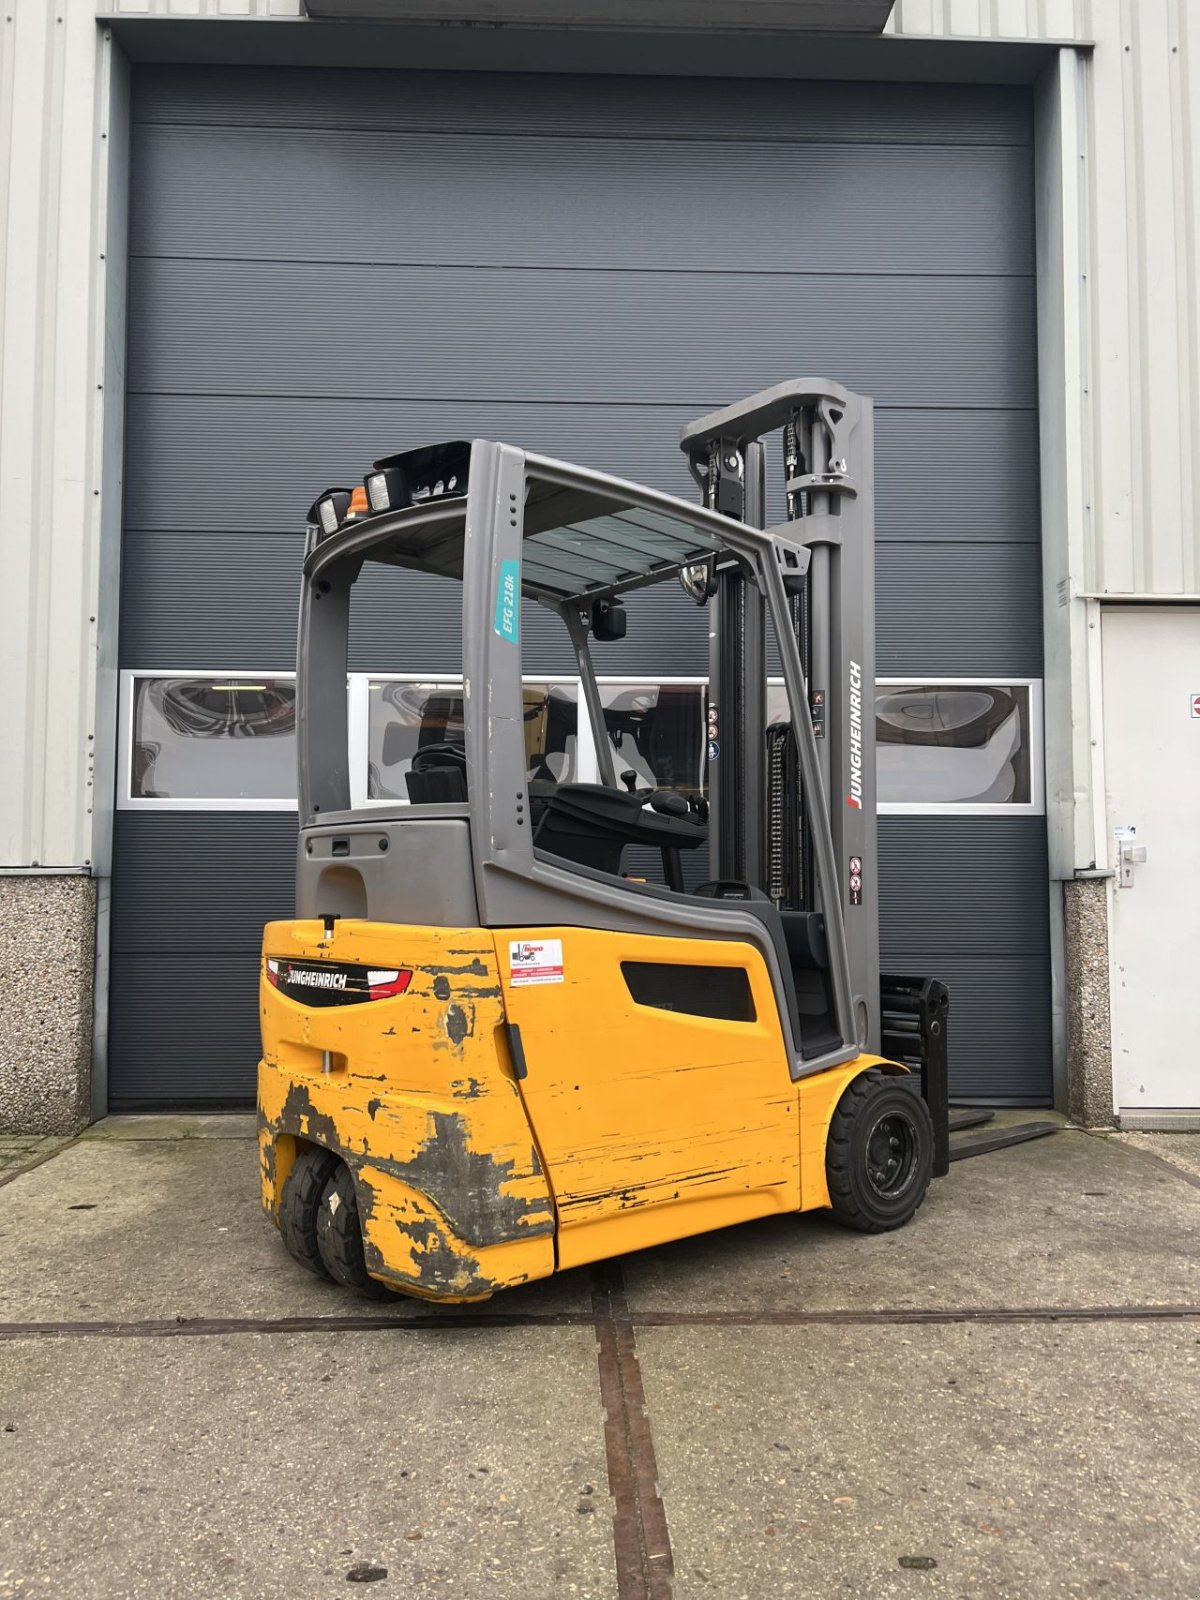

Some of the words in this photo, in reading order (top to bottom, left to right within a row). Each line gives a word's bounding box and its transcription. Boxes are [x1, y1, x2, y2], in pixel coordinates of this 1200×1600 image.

[504, 574, 515, 607] 218k
[502, 607, 514, 634] EFG
[847, 660, 862, 810] JUNGHEINRICH
[287, 964, 348, 989] JUNGHEINRICH
